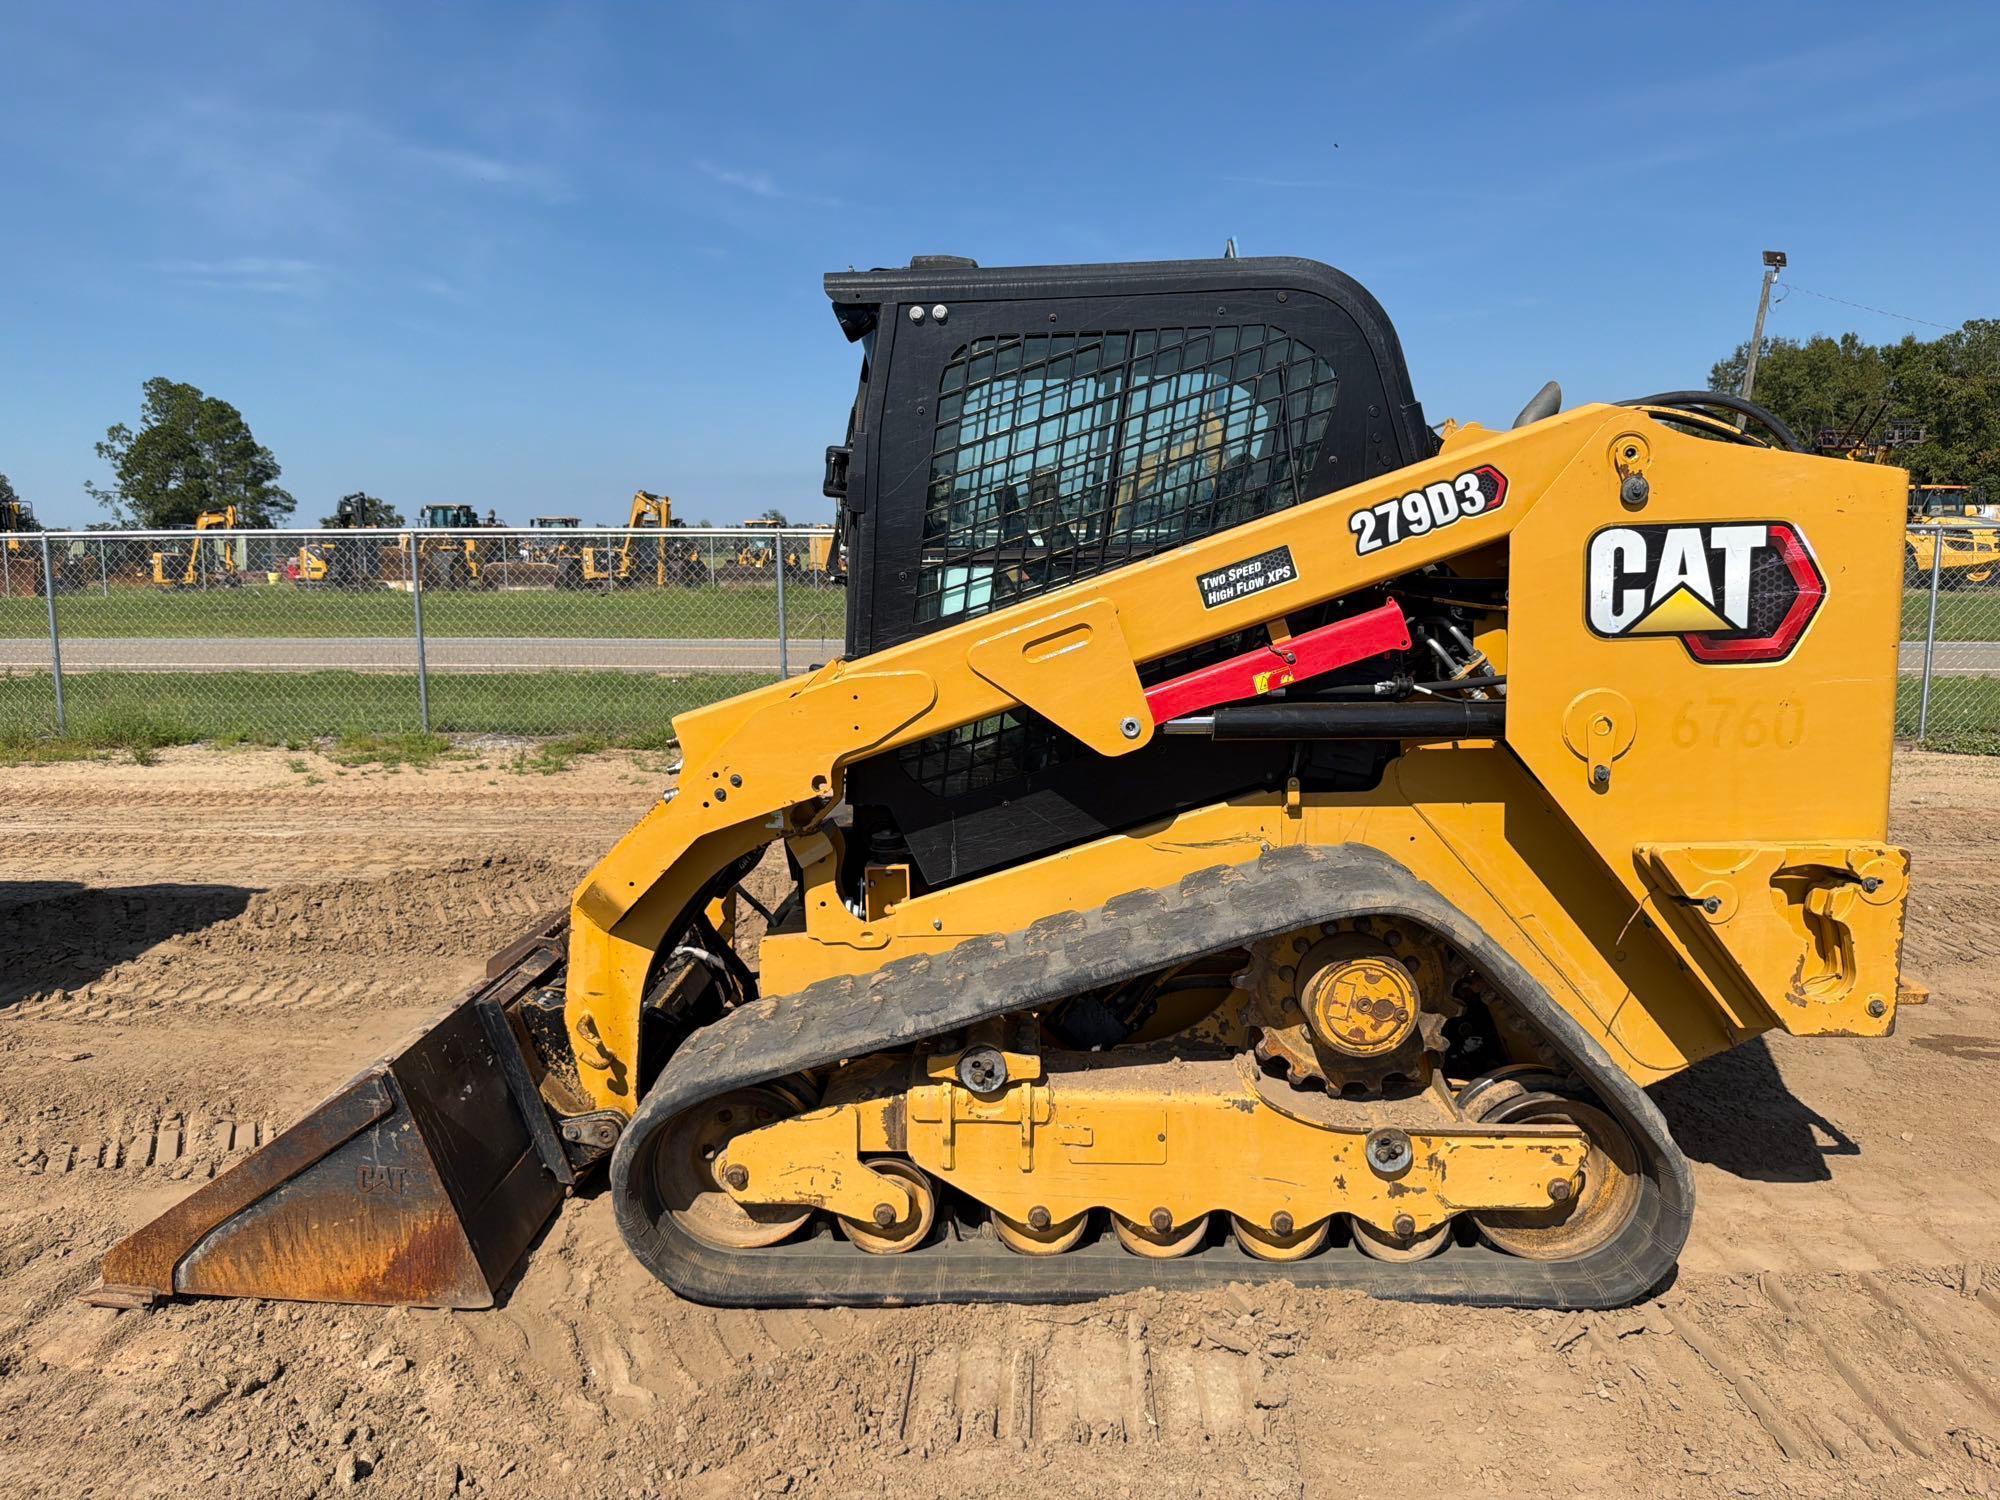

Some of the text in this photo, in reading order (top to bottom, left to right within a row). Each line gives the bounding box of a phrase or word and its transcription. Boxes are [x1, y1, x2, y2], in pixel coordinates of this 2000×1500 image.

[1350, 473, 1486, 554] 279D3
[1202, 562, 1261, 590] TWO SPEED
[1208, 565, 1291, 604] HIGH FLOW XPS
[1590, 525, 1767, 634] CAT
[1672, 697, 1805, 749] 6760
[356, 1165, 406, 1194] CAT
